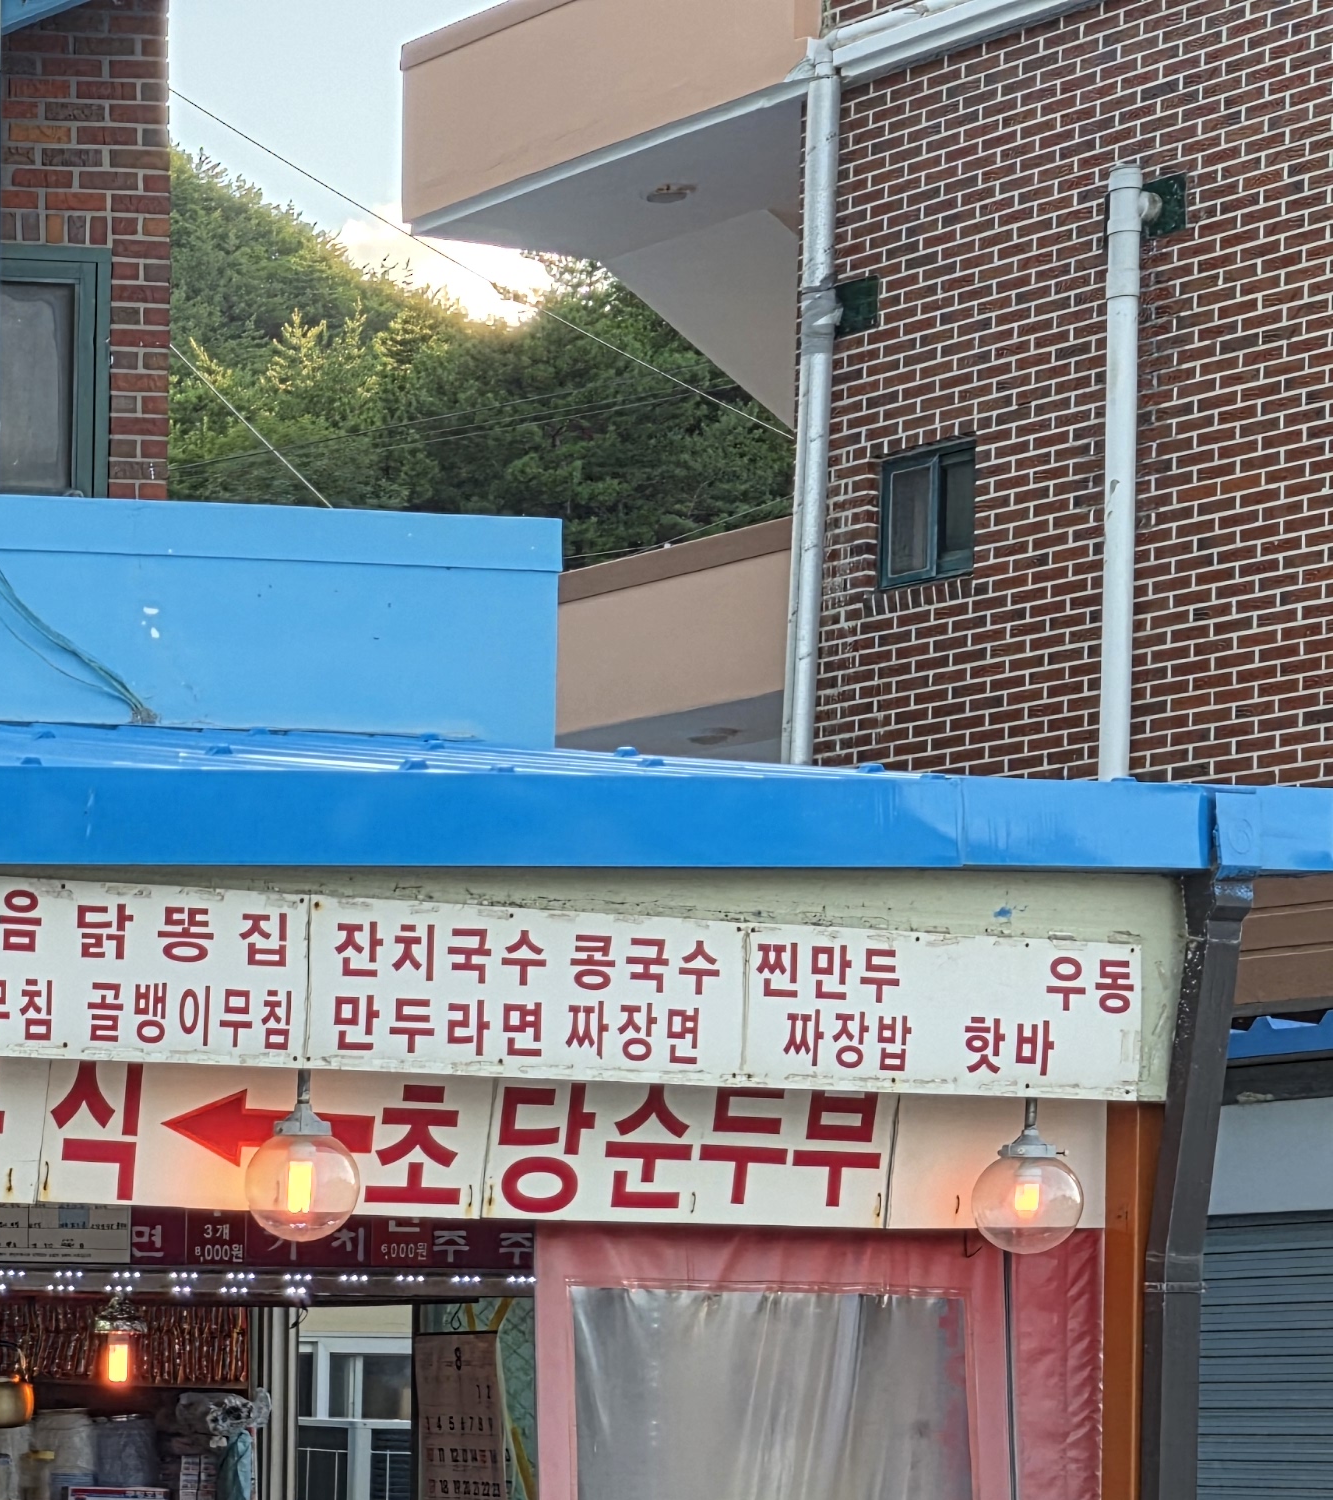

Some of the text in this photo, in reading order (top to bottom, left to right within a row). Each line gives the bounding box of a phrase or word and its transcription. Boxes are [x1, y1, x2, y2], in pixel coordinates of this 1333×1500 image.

[76, 903, 289, 968] 닭똥집
[334, 920, 722, 996] 잔치국수 콩국수
[755, 941, 1135, 1016] 찐만두 우동
[86, 981, 293, 1051] 골뱅이무침
[333, 995, 702, 1066] 만두라면 짜장면
[783, 1010, 1056, 1077] 짜장밥 핫바
[363, 1080, 882, 1214] 초당순두부
